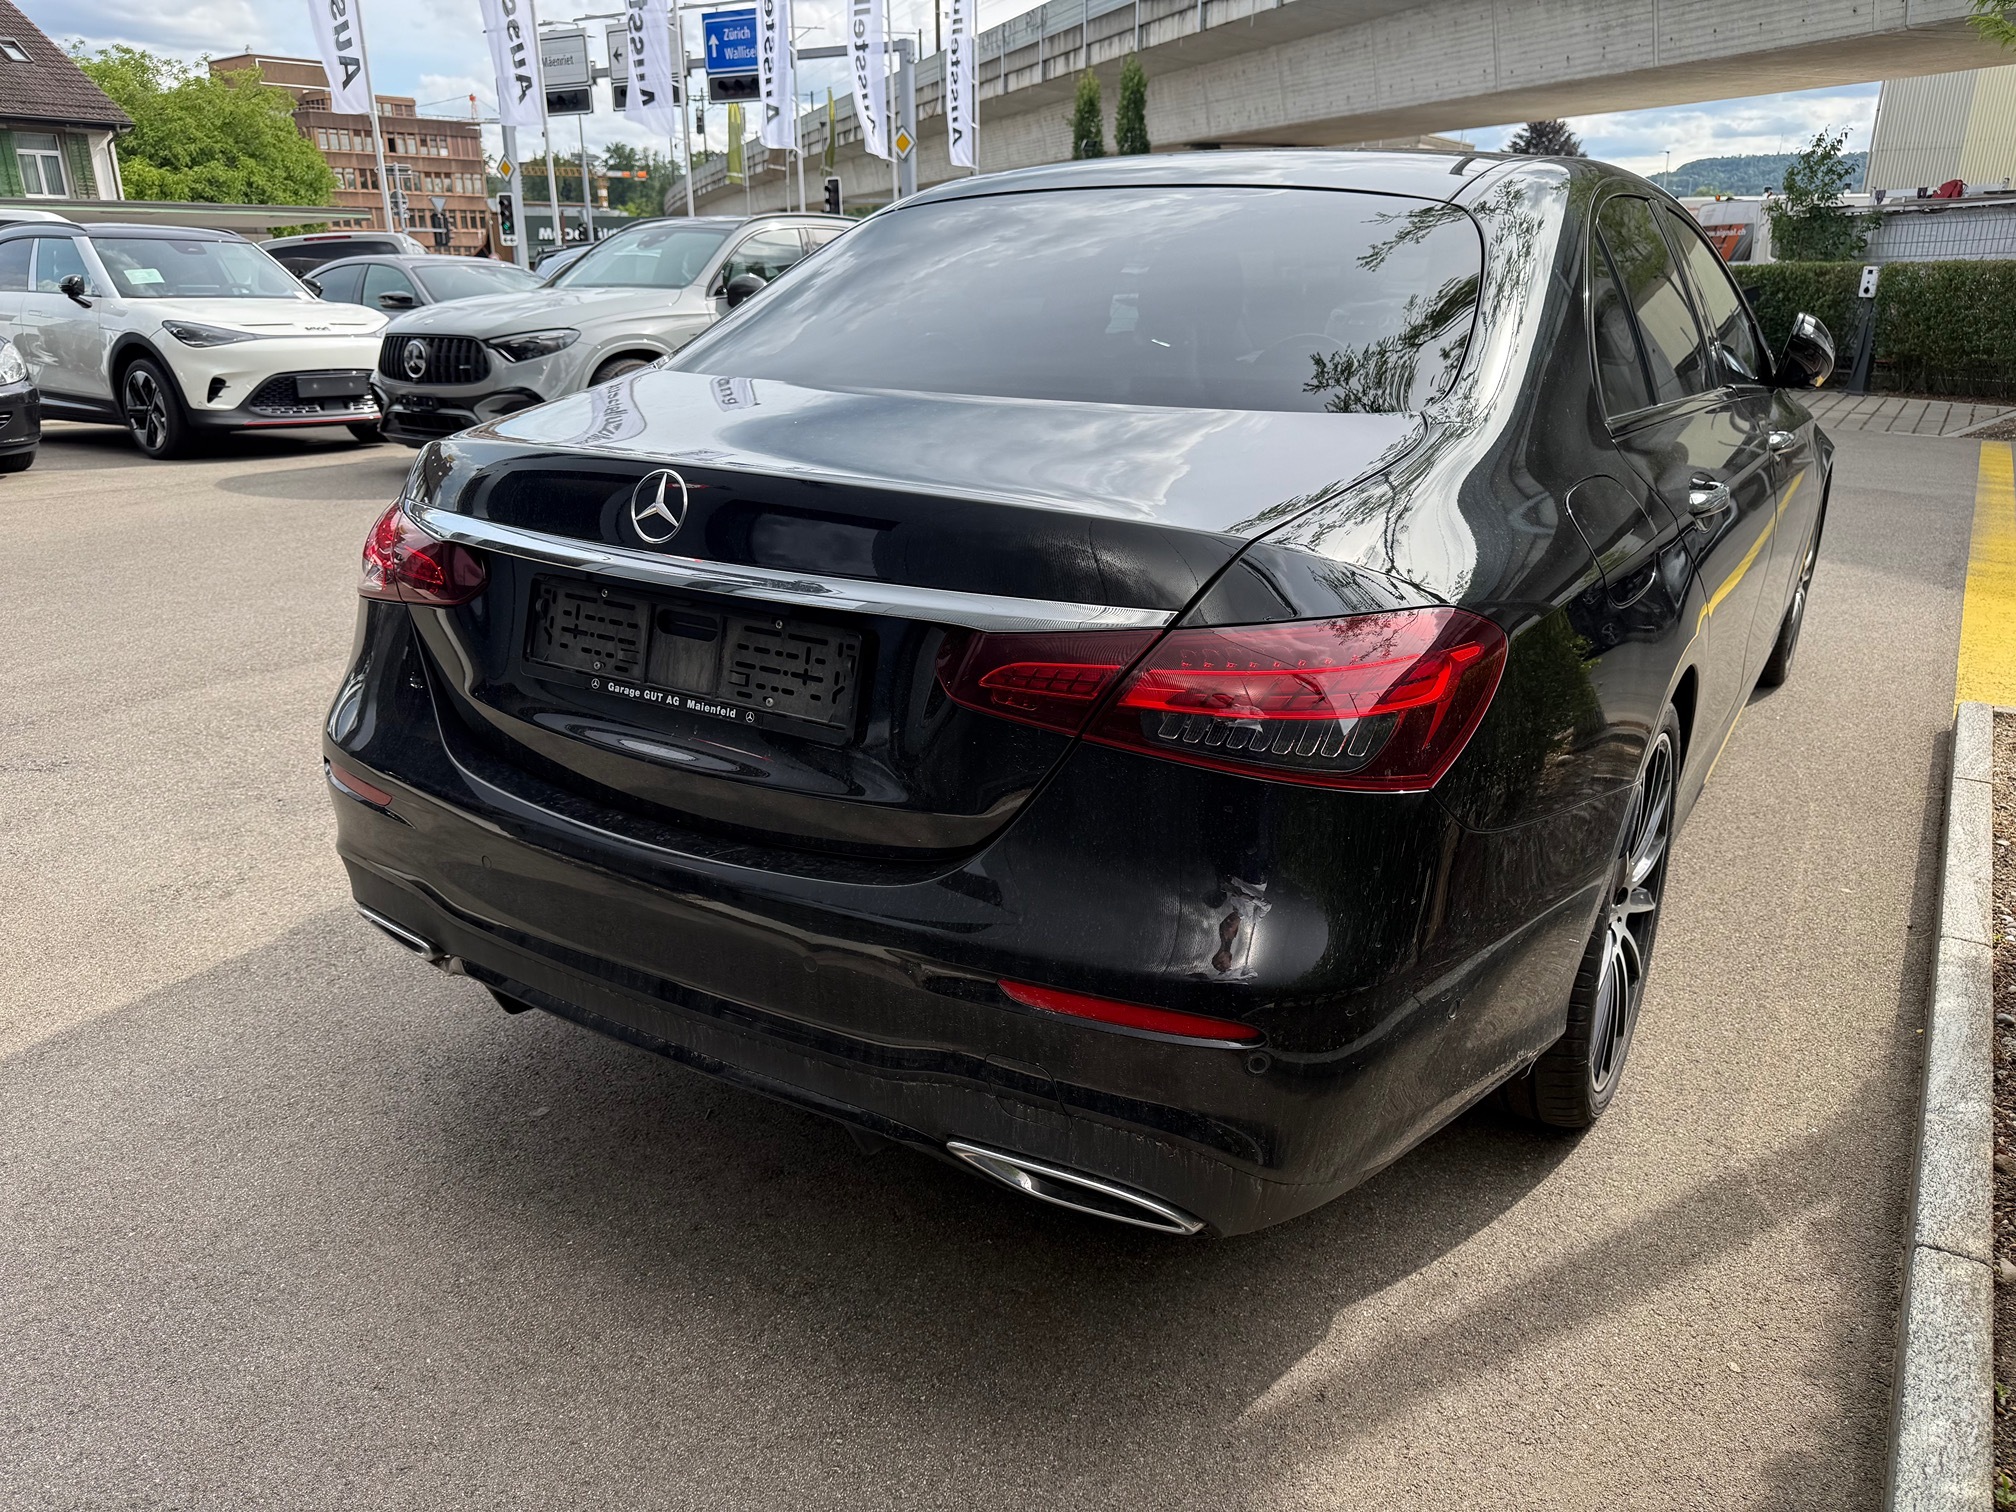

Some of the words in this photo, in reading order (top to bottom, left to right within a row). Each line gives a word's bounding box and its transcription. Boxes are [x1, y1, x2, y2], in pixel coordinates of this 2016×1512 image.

[723, 25, 751, 41] Zürich
[607, 682, 641, 698] Garage
[643, 690, 663, 702] GUT
[666, 696, 680, 706] AG
[686, 699, 737, 718] Maienfeld
